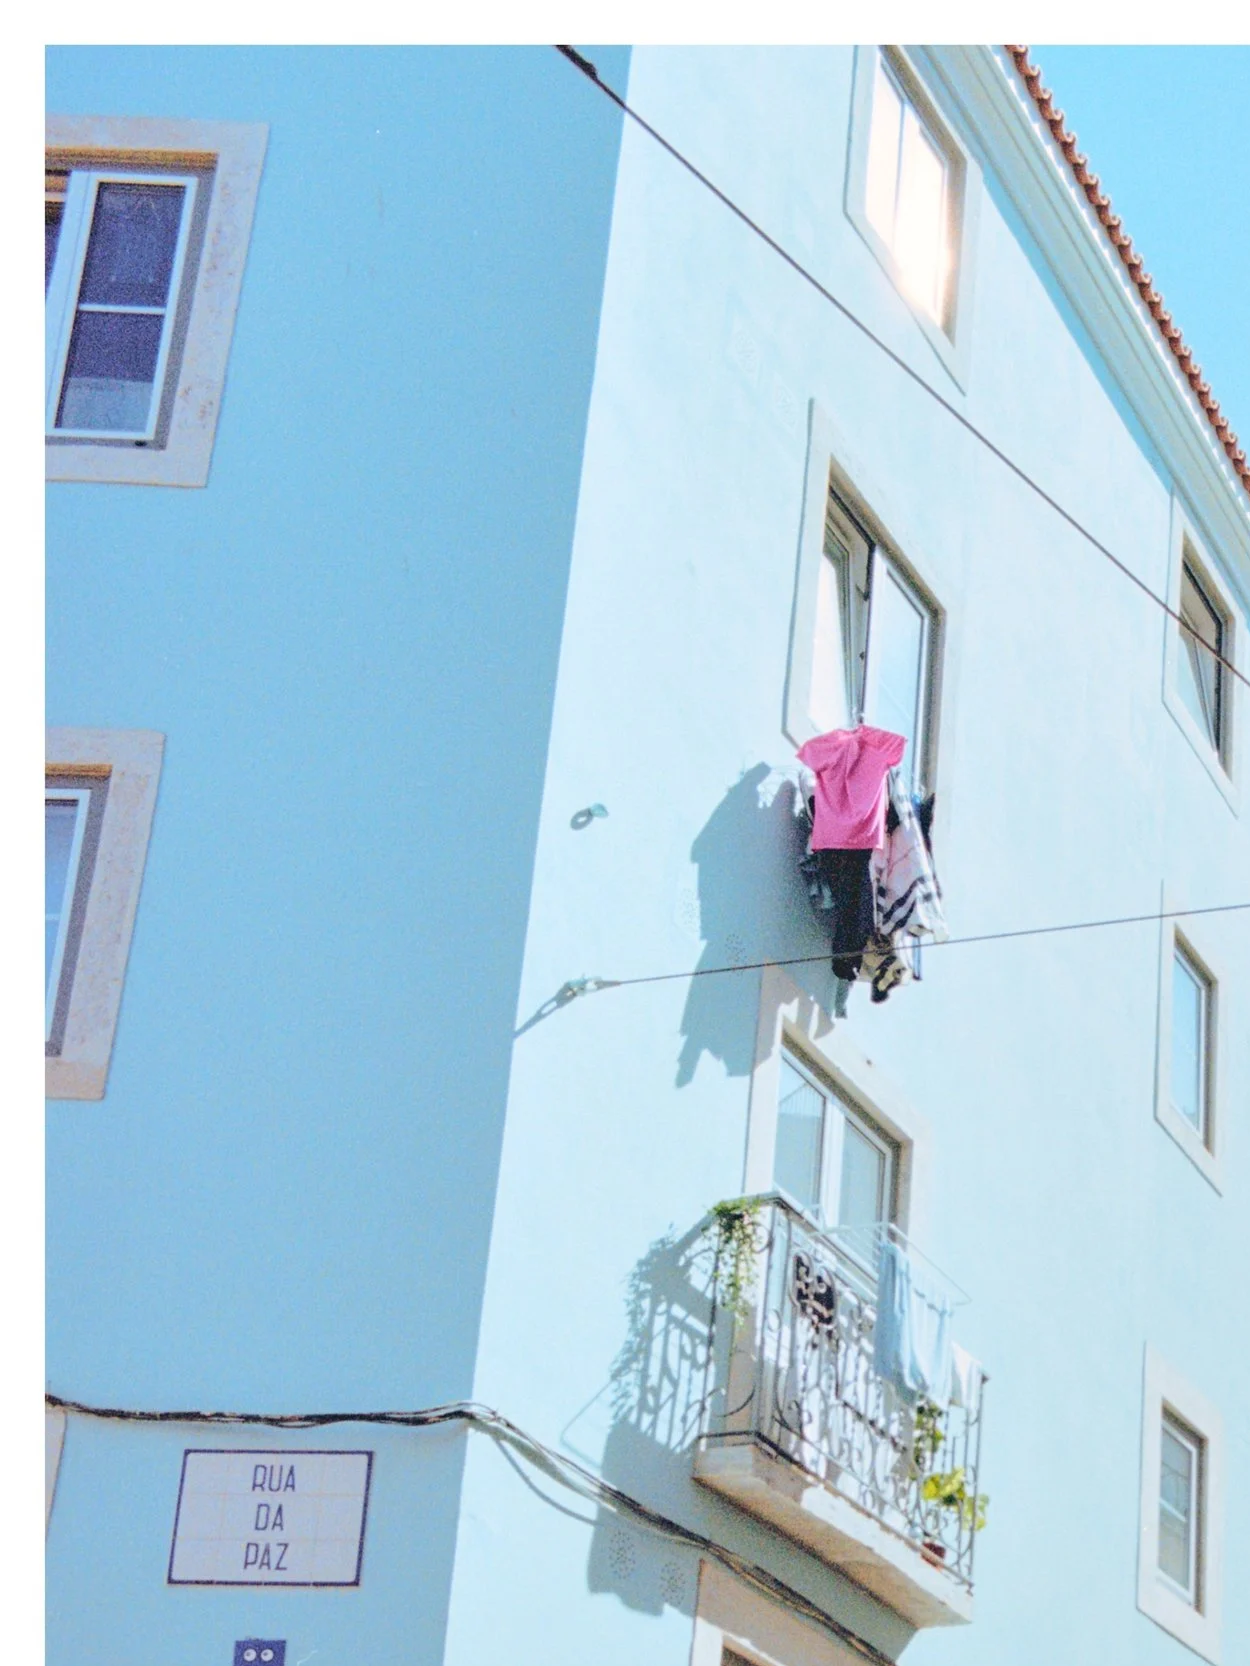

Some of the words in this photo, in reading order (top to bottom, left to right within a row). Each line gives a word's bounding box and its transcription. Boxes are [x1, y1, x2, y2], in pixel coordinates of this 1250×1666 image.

[252, 1464, 296, 1492] RUA
[254, 1503, 284, 1531] DA
[243, 1542, 289, 1571] PAZ
